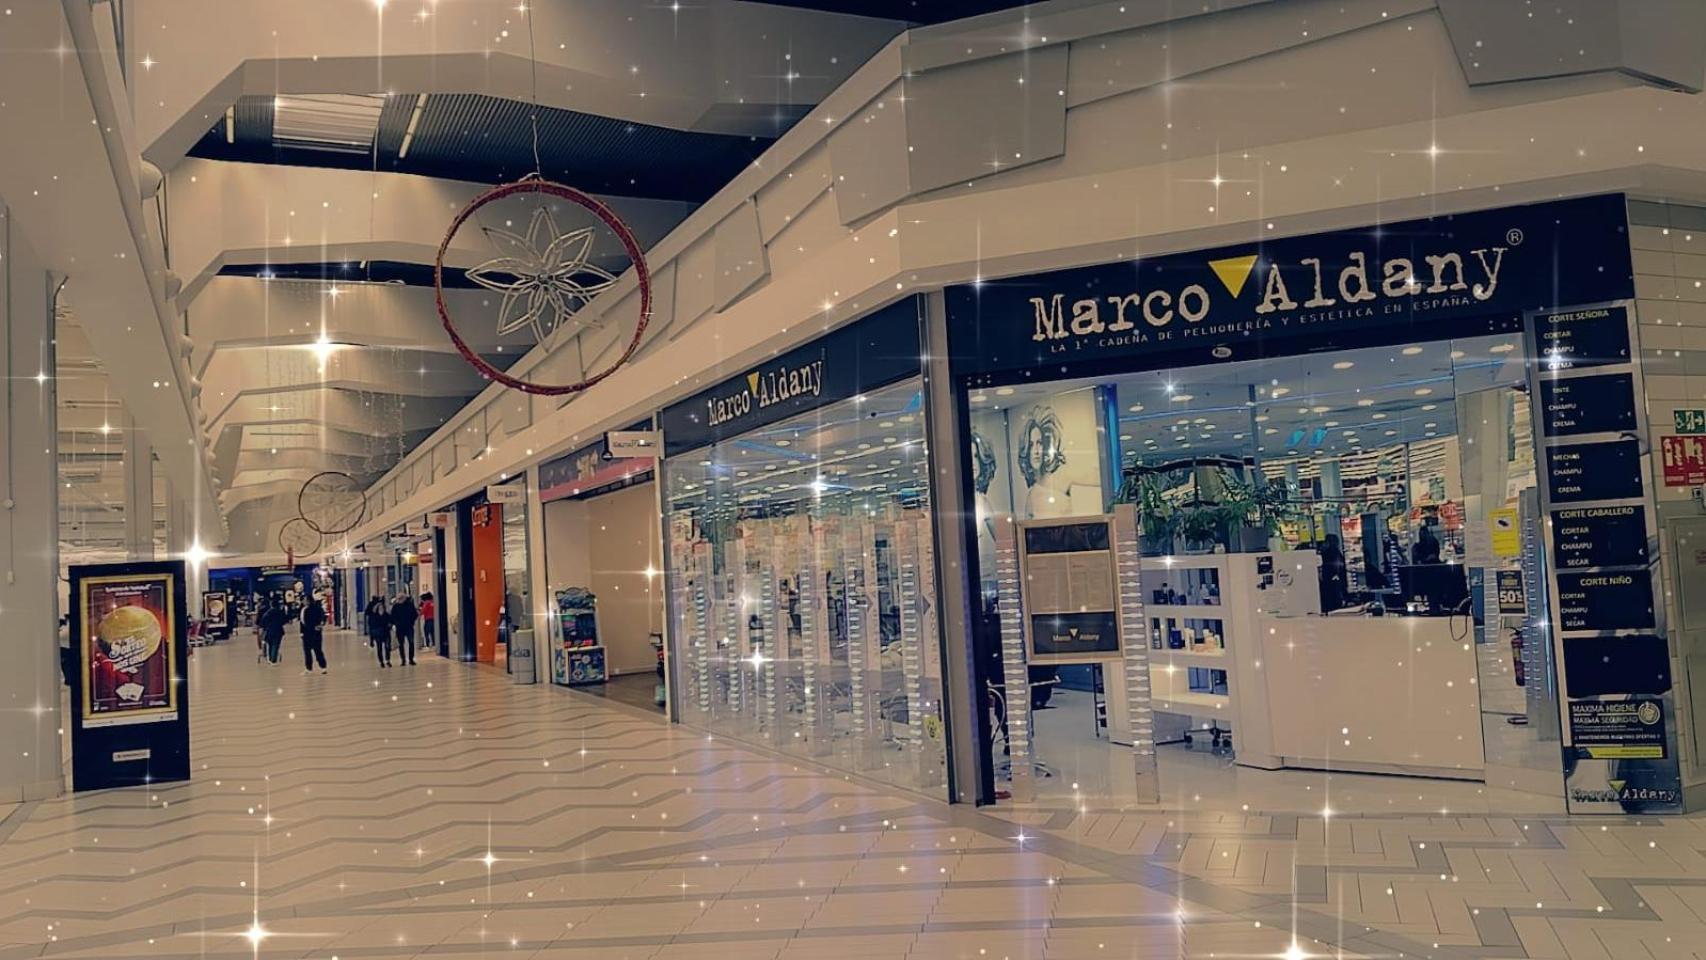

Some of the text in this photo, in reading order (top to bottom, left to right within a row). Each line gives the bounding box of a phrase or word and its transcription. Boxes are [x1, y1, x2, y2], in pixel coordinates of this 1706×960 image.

[1030, 284, 1210, 341] Marco
[1256, 248, 1508, 314] Aldany
[1548, 314, 1575, 323] CORTE
[1051, 344, 1066, 353] LA
[1158, 331, 1173, 340] DE
[1281, 317, 1289, 326] Y
[1384, 304, 1402, 314] EN
[1544, 331, 1571, 339] CORTAR
[708, 361, 822, 426] Marco Aldany
[1560, 507, 1634, 519] CORTE CABALLERO
[1580, 578, 1608, 586] CORTE
[1606, 704, 1637, 712] HIGIENE
[1622, 788, 1676, 801] Aldany
